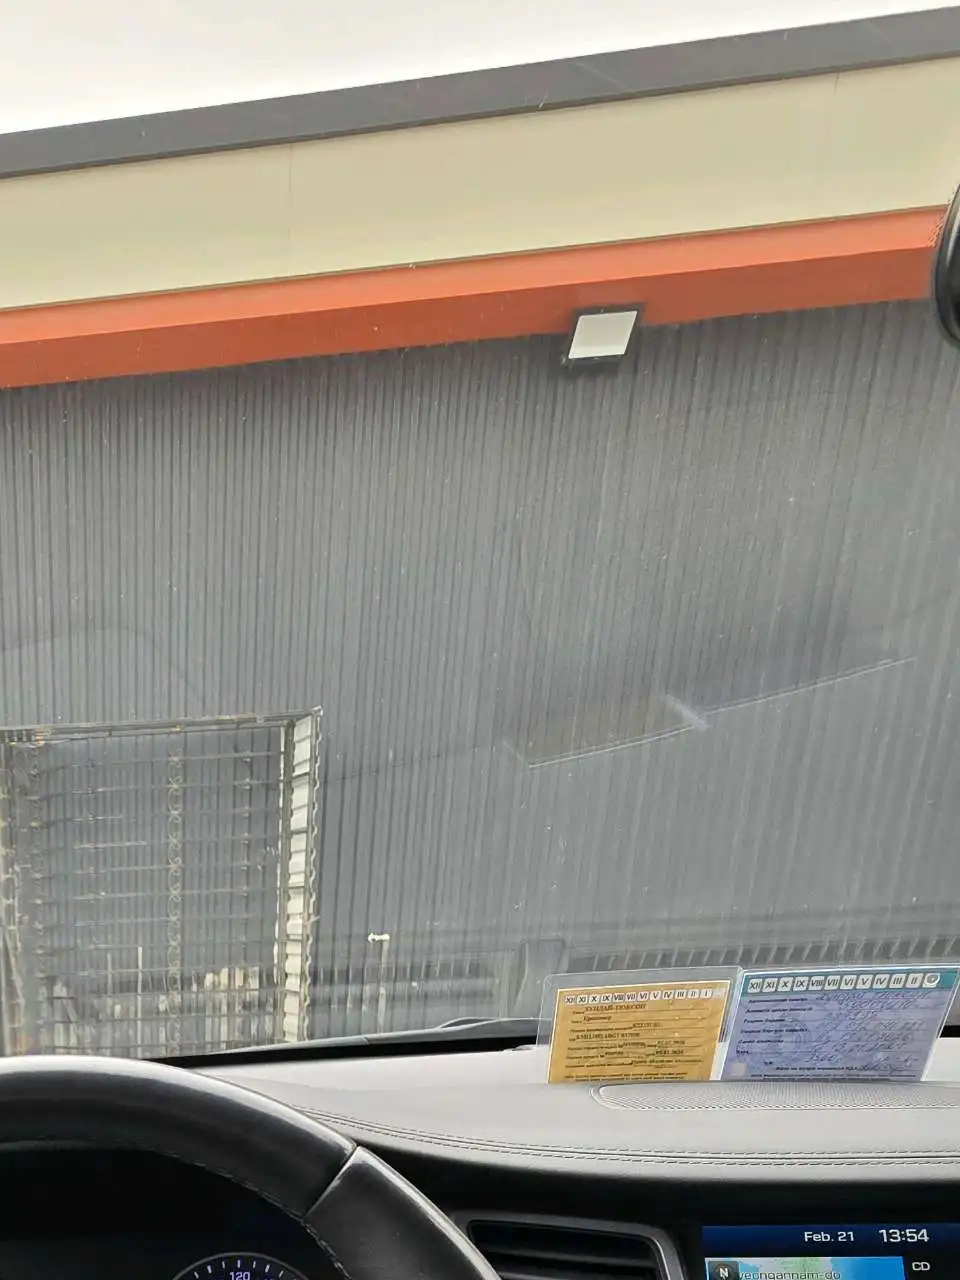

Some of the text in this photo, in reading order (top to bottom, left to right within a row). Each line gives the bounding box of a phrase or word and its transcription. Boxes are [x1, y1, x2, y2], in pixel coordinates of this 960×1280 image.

[875, 977, 886, 985] IV
[892, 977, 903, 985] III
[804, 1232, 854, 1242] Feb. 21
[879, 1229, 929, 1242] 13:54
[912, 1262, 930, 1271] CD
[719, 1266, 729, 1278] N
